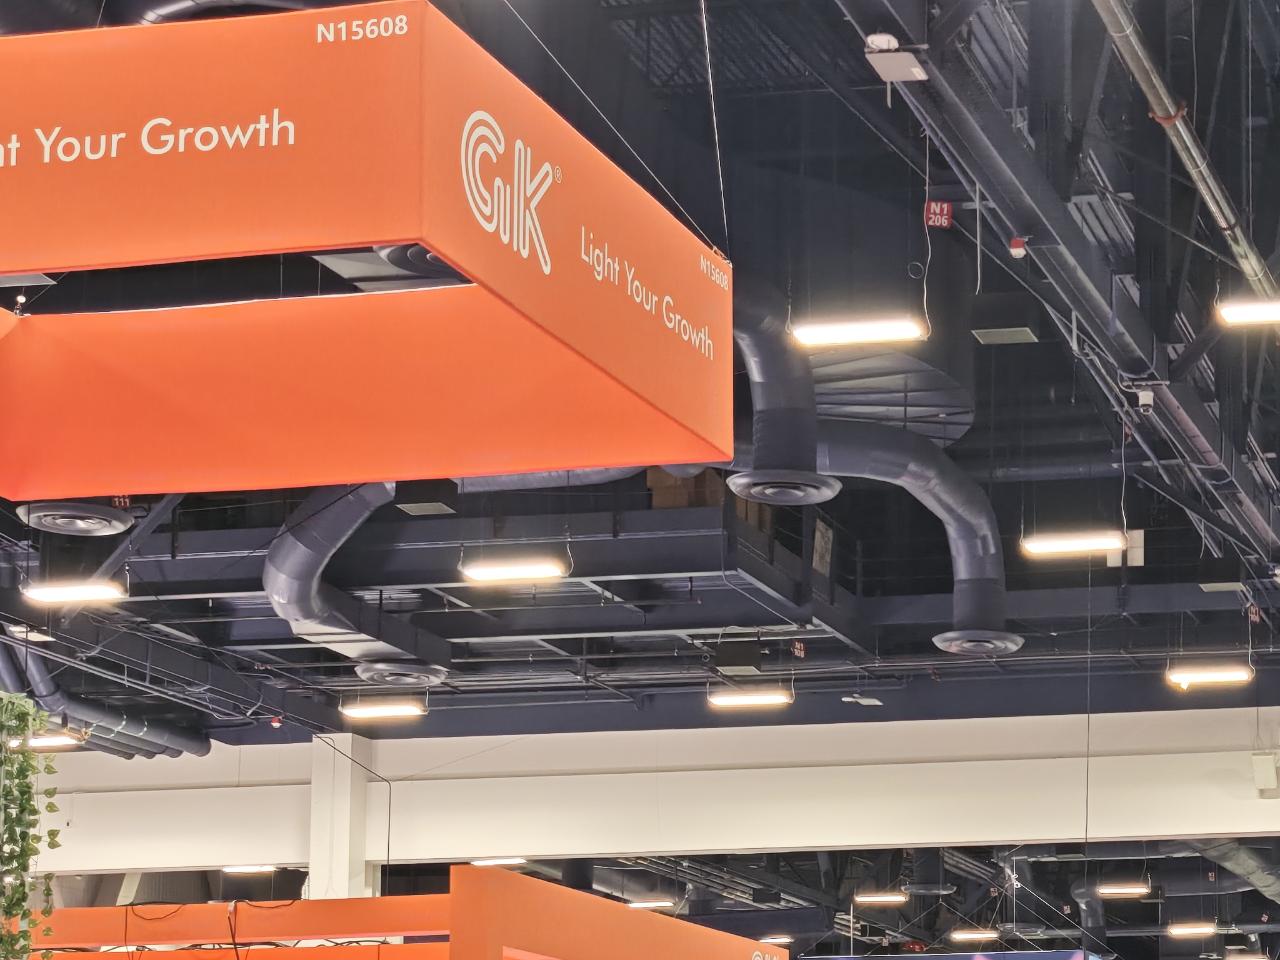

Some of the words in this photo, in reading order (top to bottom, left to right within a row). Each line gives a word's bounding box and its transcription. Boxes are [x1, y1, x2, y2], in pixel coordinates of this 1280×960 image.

[316, 14, 409, 44] N15608
[34, 126, 127, 164] Your
[140, 107, 295, 155] Growth
[928, 214, 948, 226] 206
[930, 202, 948, 214] N1
[699, 254, 729, 291] N15608
[580, 224, 620, 286] Light
[625, 260, 659, 316] Your
[662, 295, 715, 361] Growth
